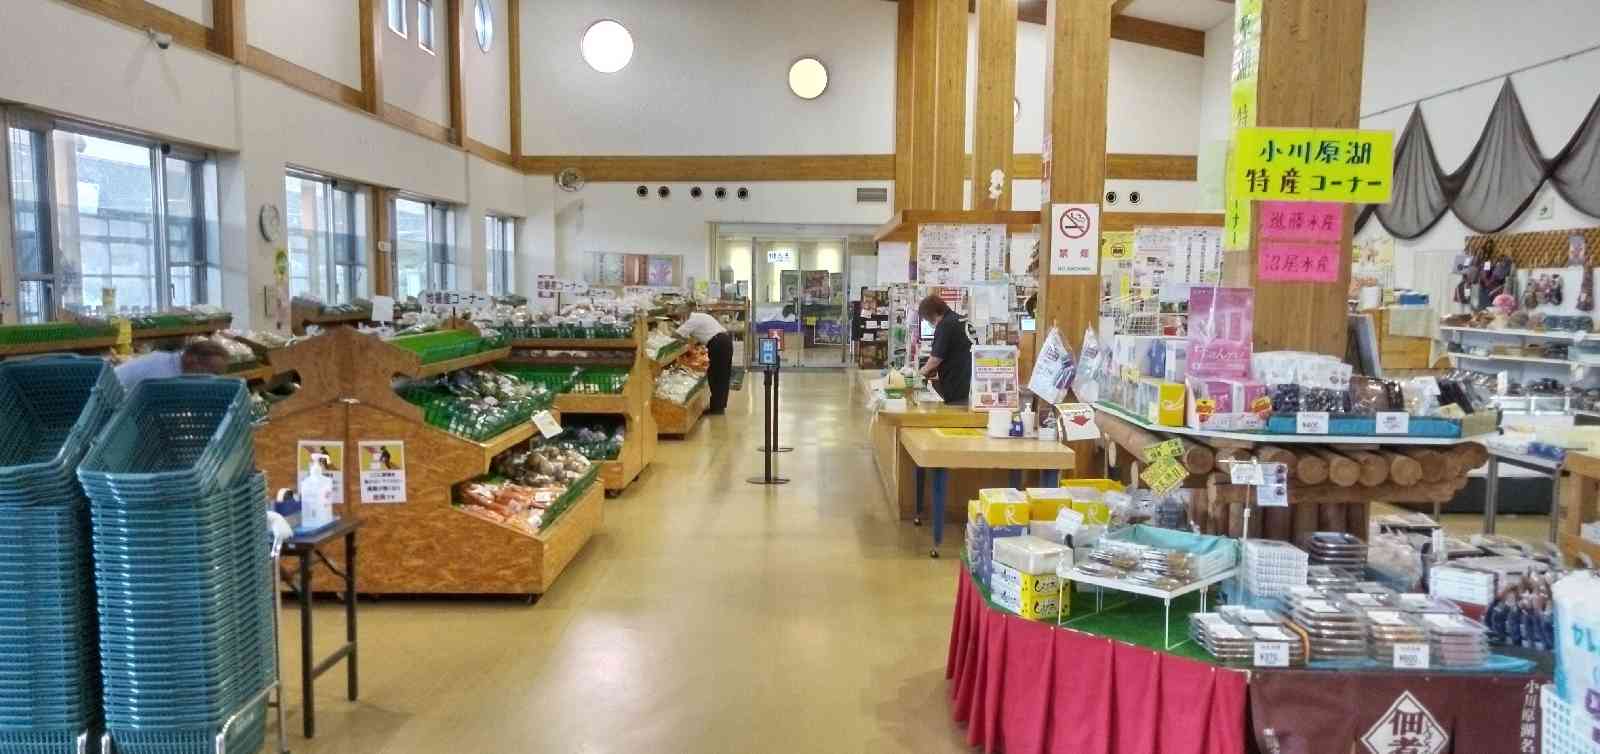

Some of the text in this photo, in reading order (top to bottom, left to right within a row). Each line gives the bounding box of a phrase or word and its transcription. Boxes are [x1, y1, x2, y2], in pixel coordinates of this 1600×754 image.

[1259, 139, 1373, 166] 小川原湖
[763, 341, 773, 364] 出口
